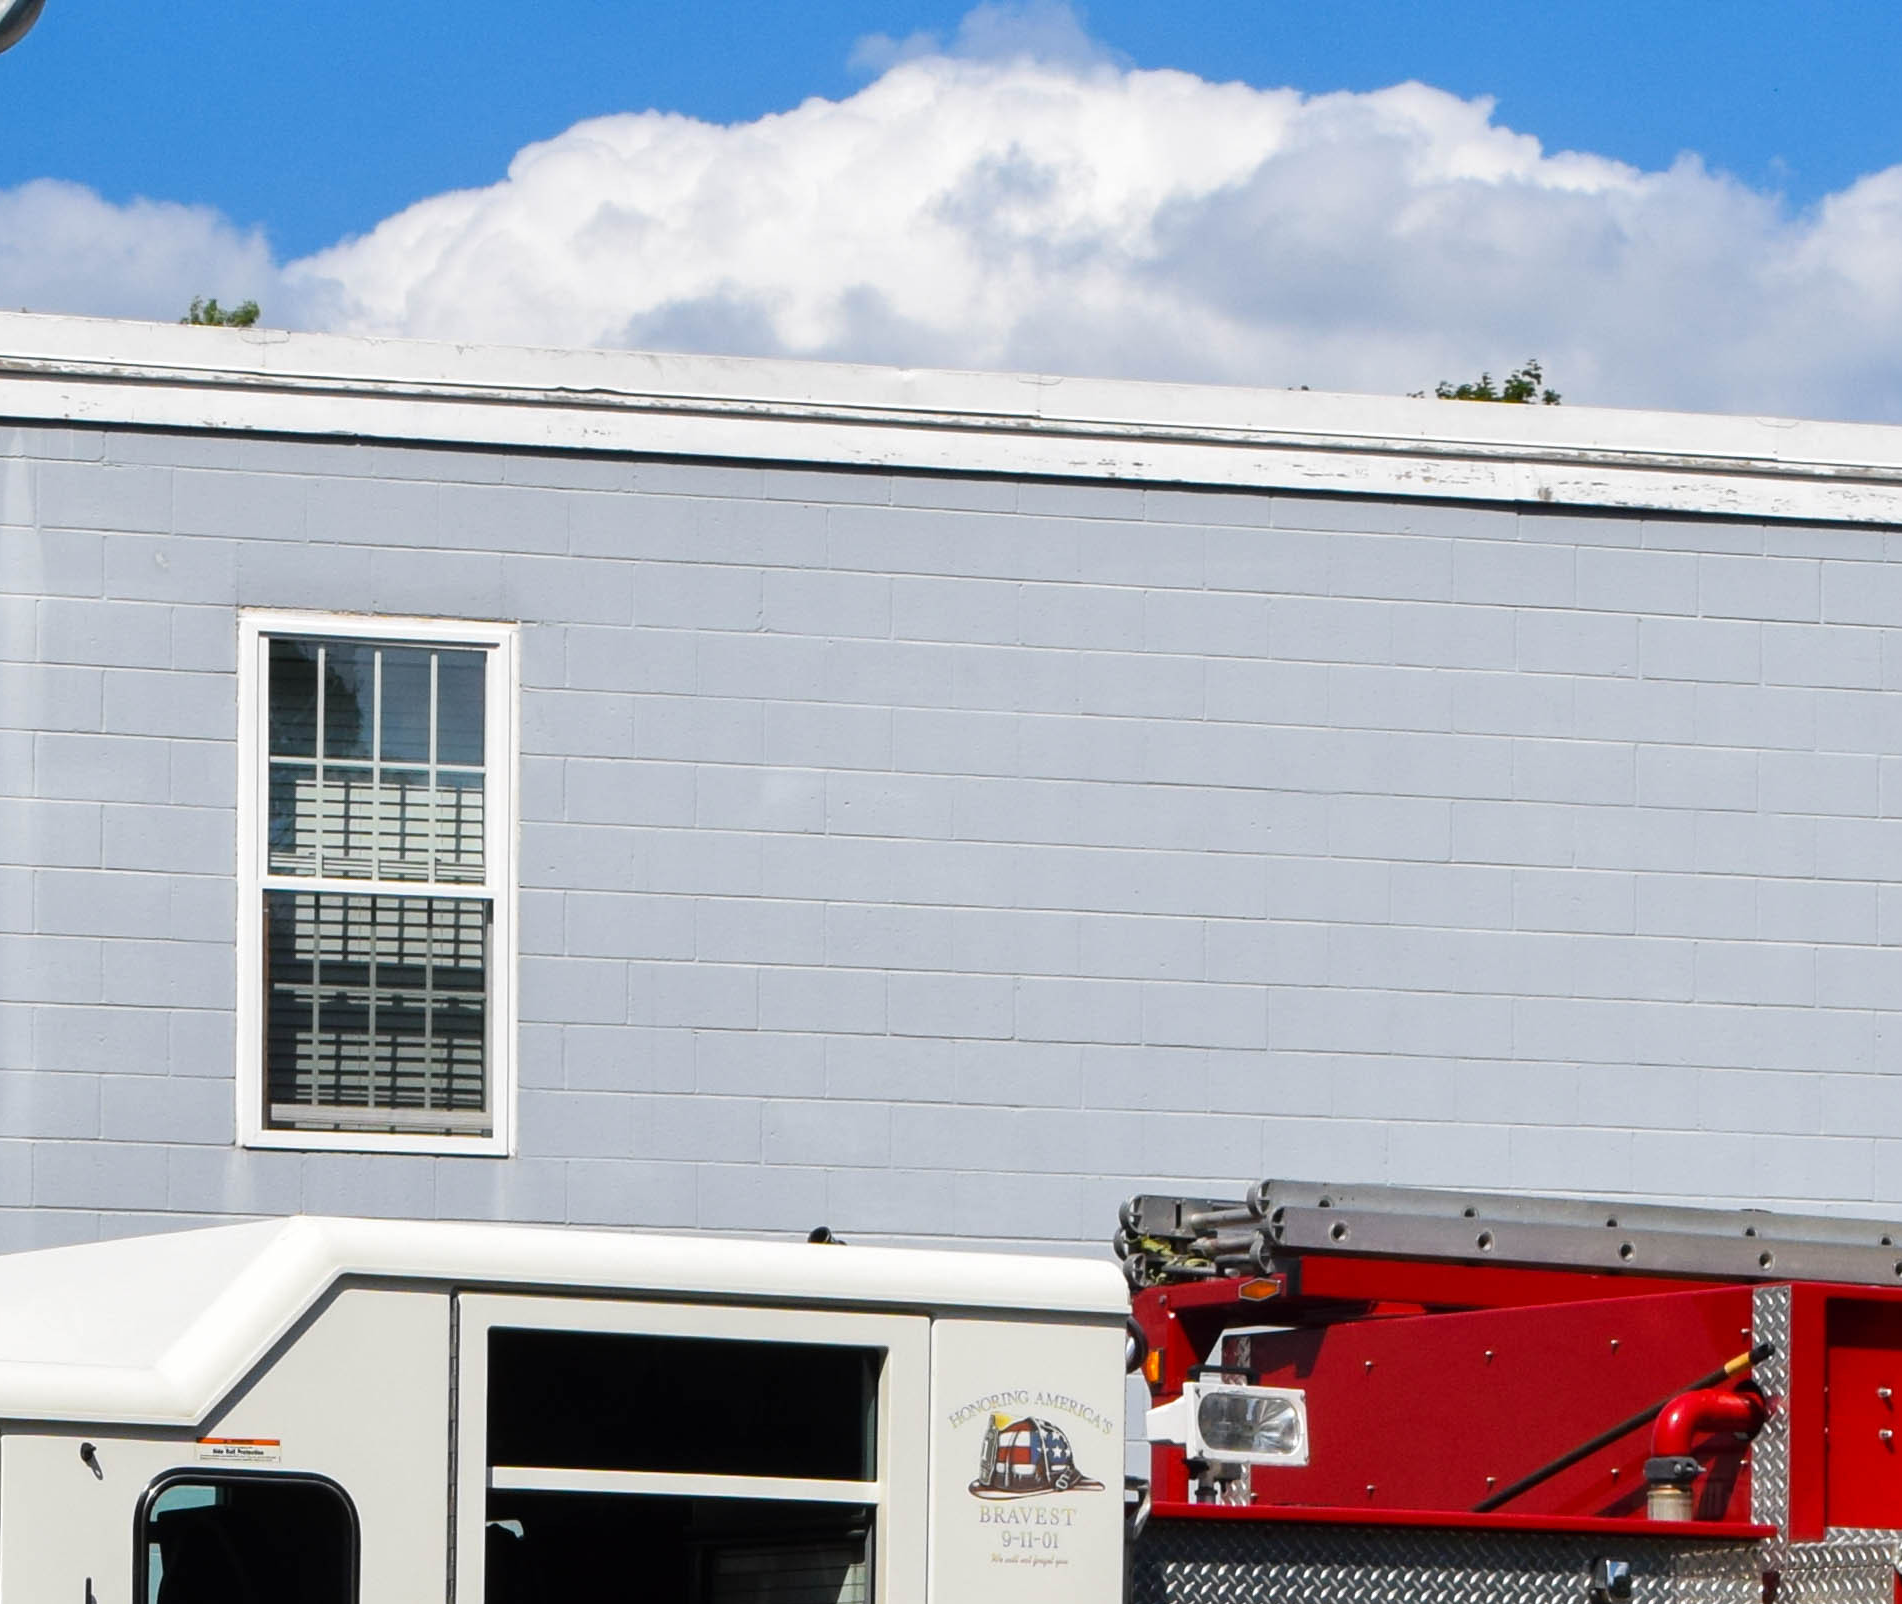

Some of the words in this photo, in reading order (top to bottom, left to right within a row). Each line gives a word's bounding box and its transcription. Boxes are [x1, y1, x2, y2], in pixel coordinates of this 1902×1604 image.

[949, 1390, 1029, 1429] HONORING
[1034, 1392, 1114, 1434] AMERICA'S
[979, 1506, 1076, 1526] BRAVEST
[1002, 1532, 1059, 1549] 9-11-01
